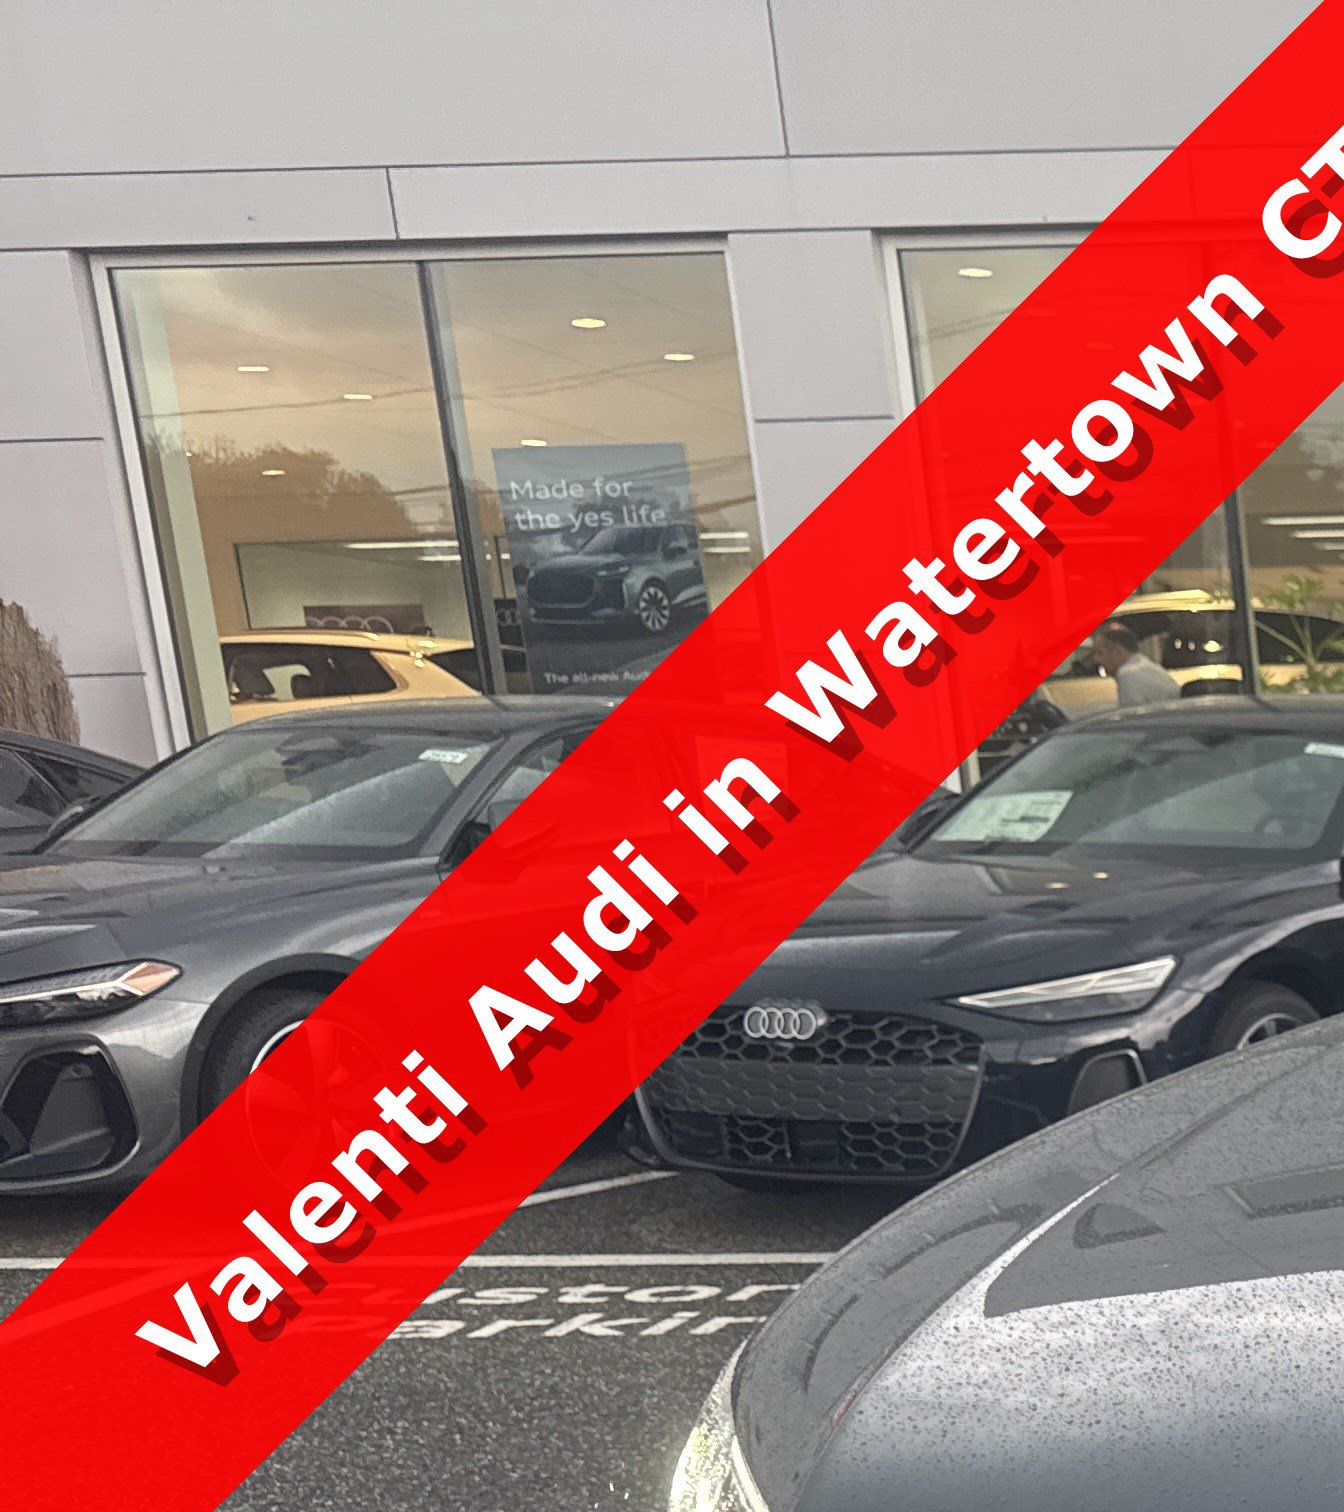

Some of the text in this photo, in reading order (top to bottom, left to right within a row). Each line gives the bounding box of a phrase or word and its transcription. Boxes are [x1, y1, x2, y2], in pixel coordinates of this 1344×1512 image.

[510, 477, 634, 501] Made for
[514, 505, 667, 533] the yes life
